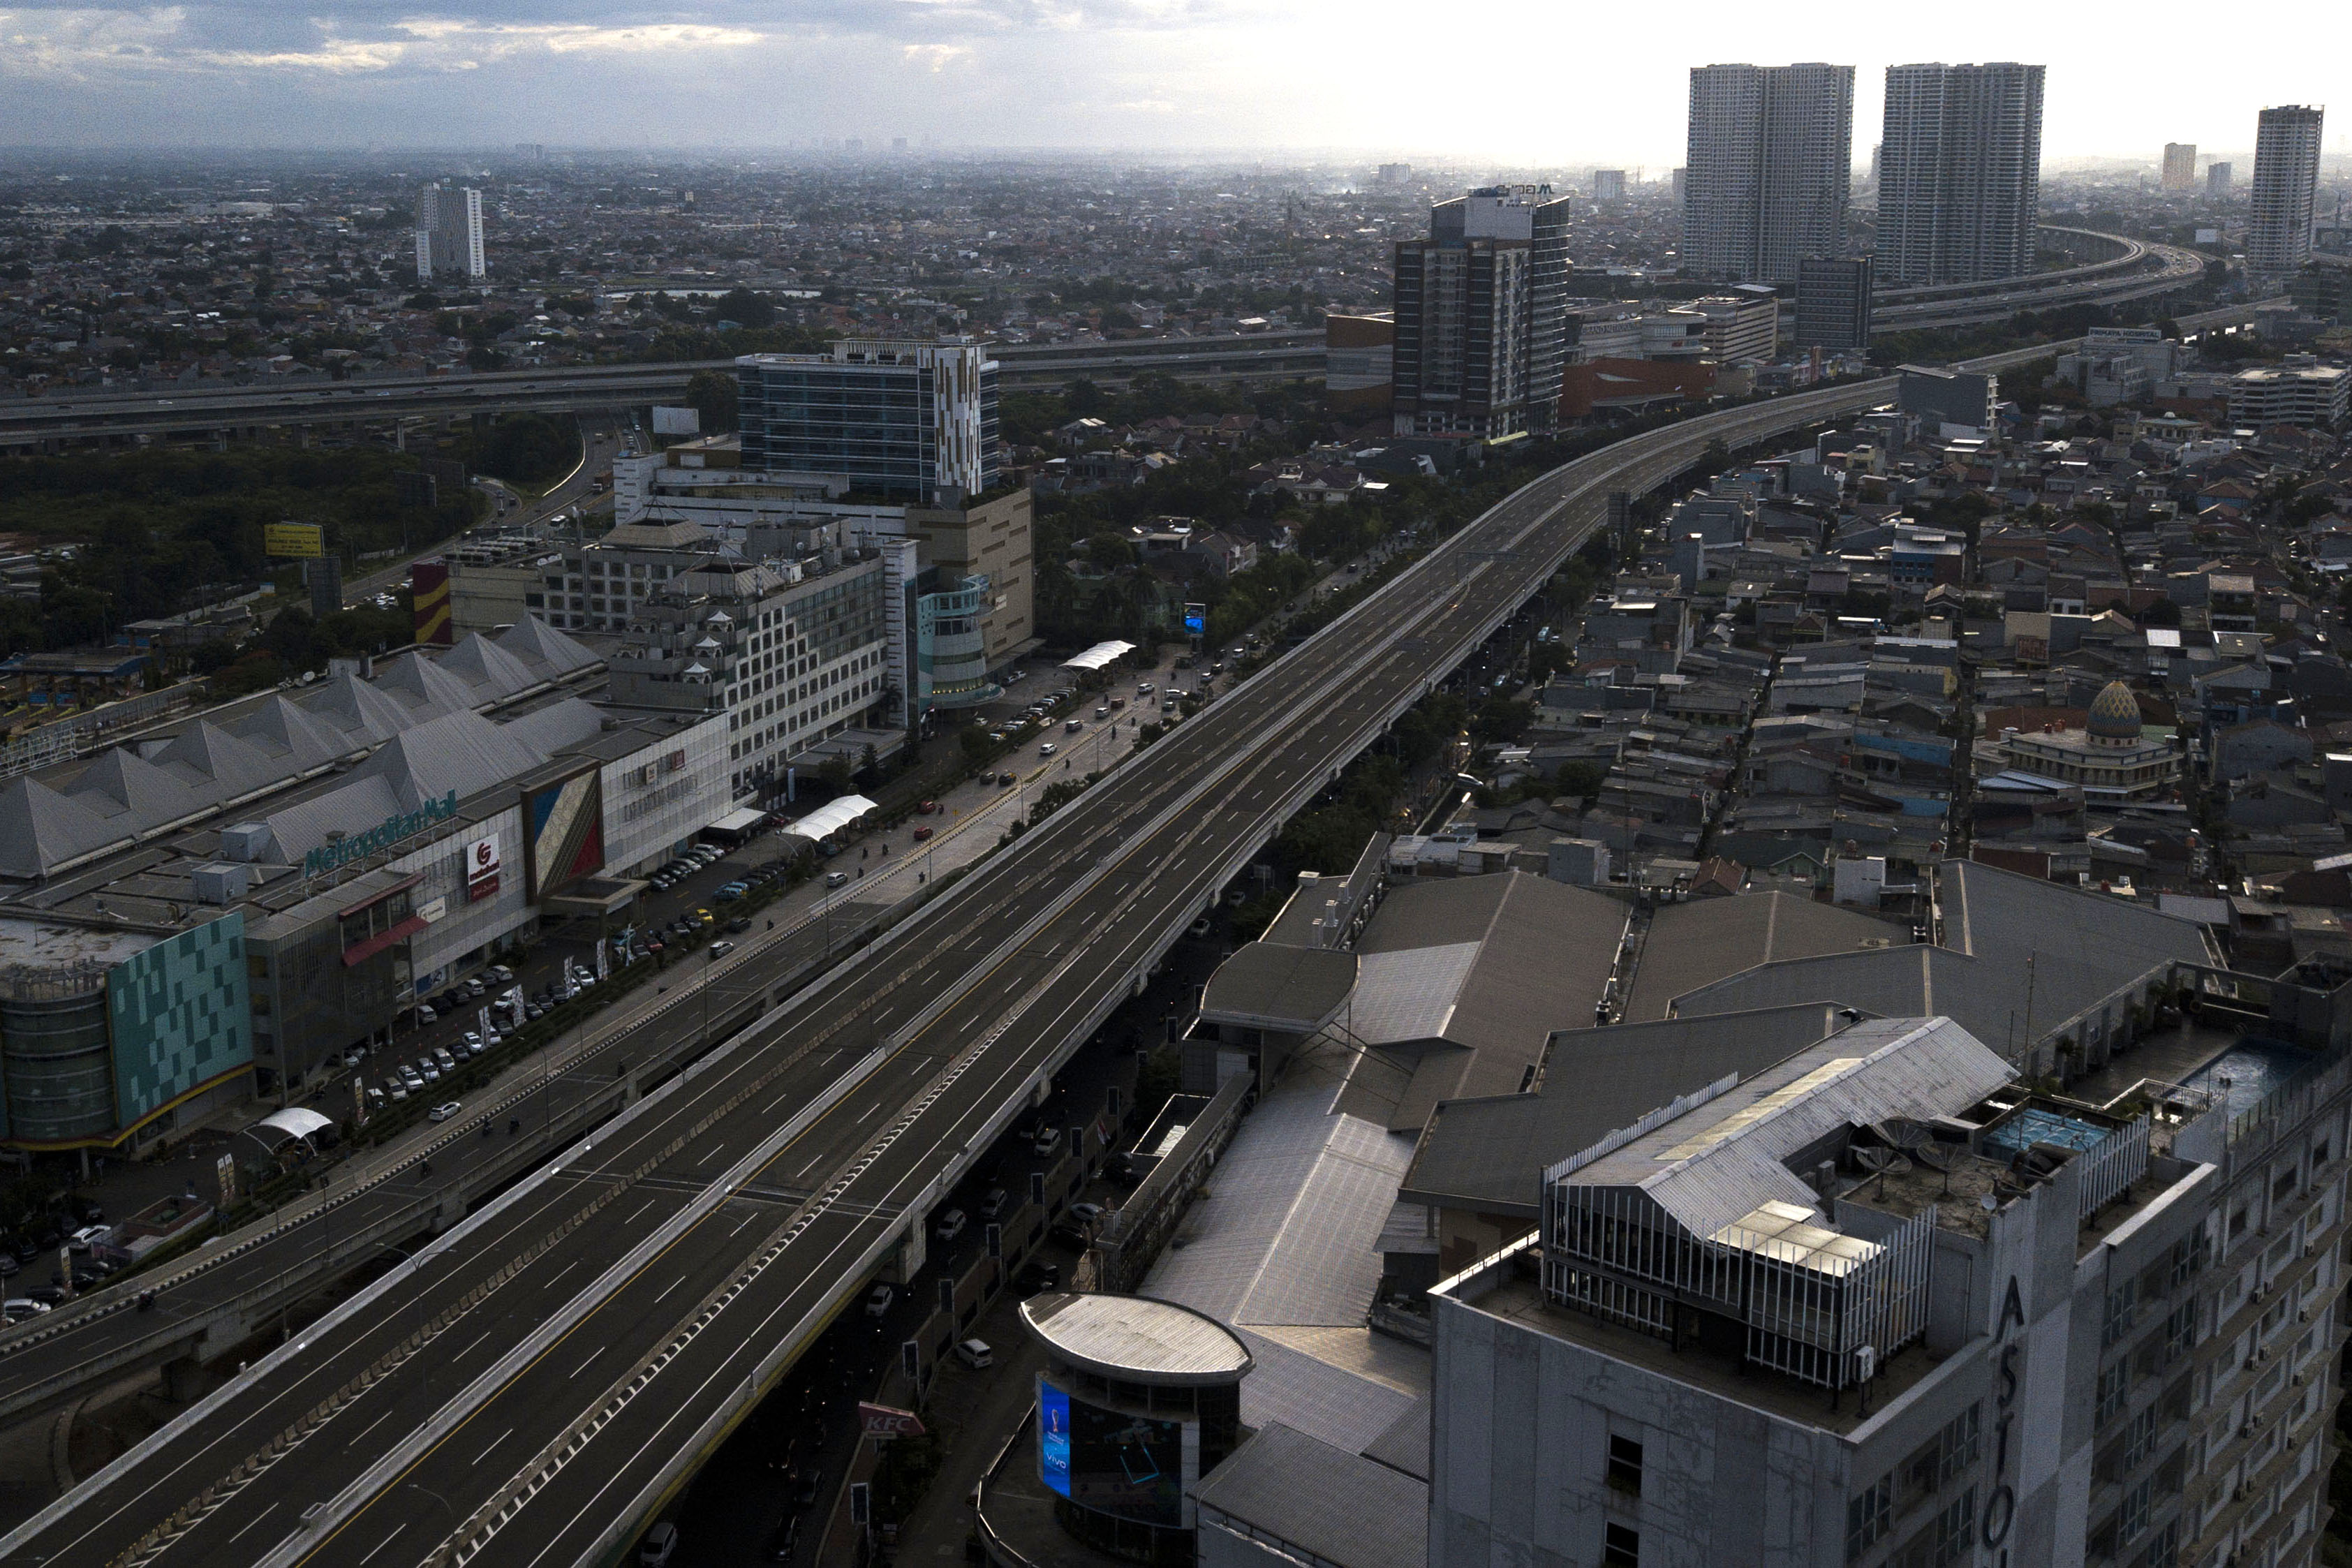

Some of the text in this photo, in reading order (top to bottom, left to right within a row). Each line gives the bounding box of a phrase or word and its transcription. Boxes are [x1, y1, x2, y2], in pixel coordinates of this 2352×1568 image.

[2123, 330, 2159, 338] HOSPITAL
[305, 789, 457, 878] Metropolitan Mall
[866, 1416, 912, 1432] KFC
[1982, 1275, 2025, 1568] ASTO
[1046, 1451, 1067, 1470] vivo
